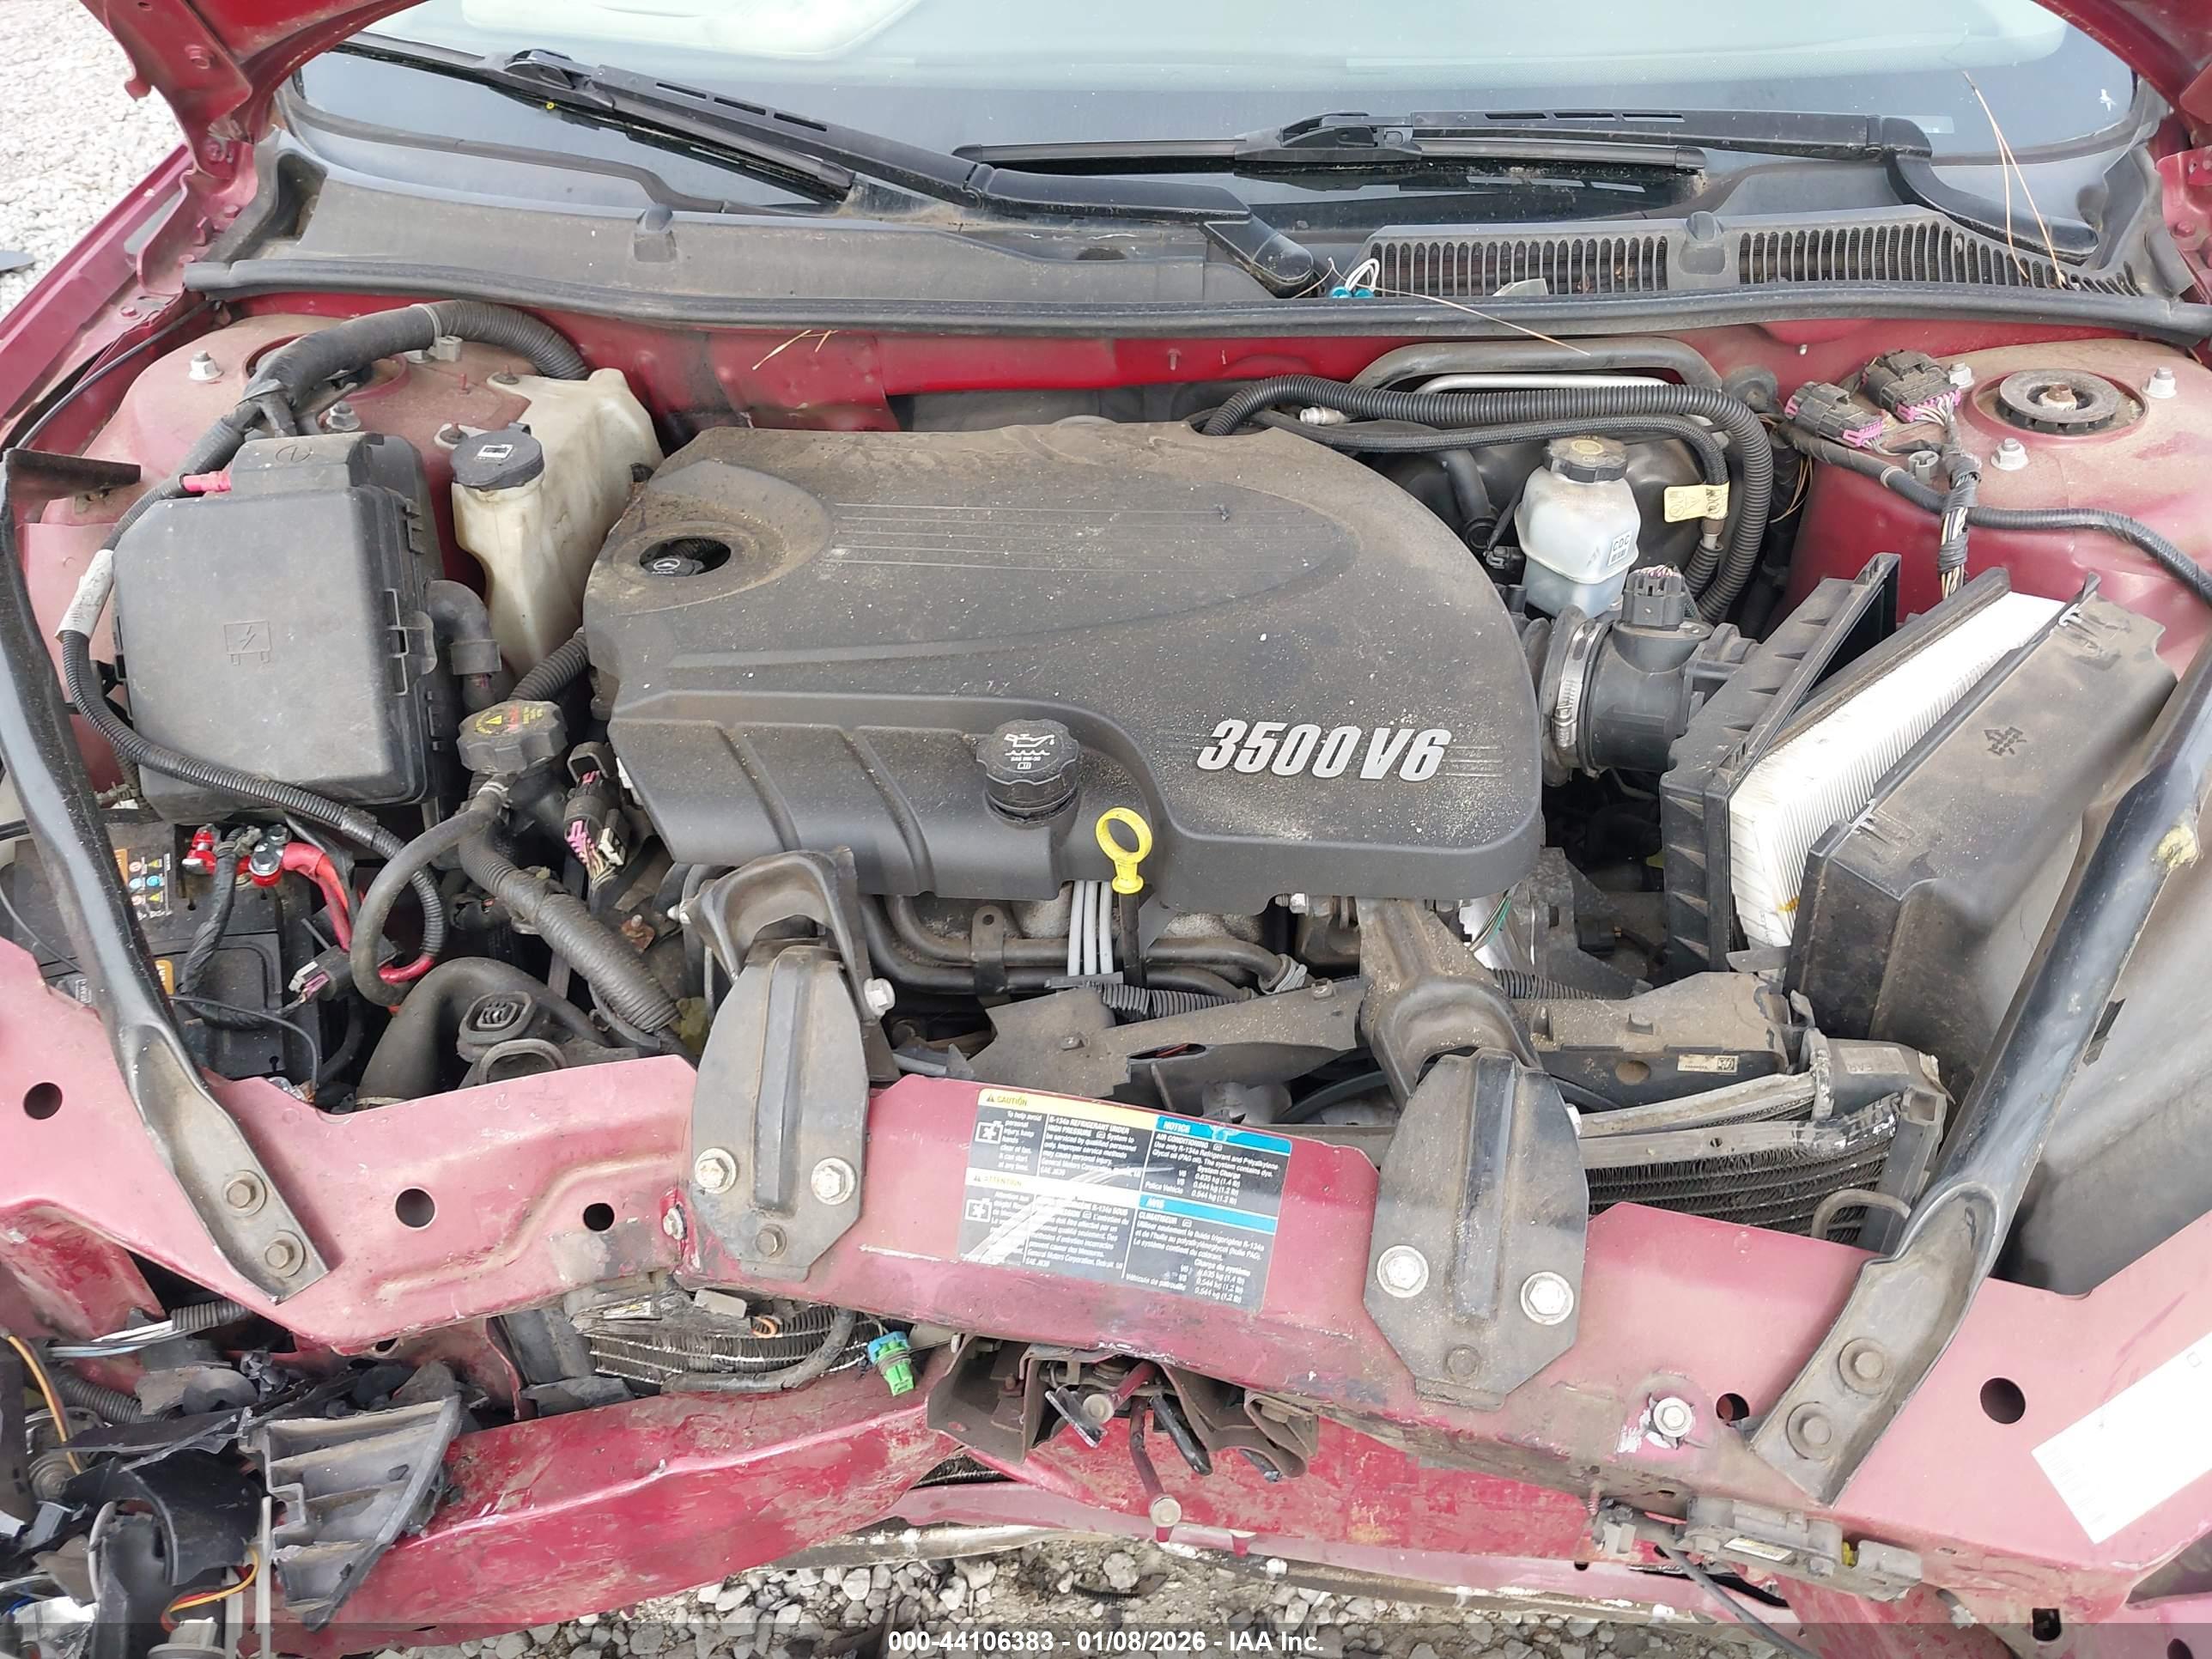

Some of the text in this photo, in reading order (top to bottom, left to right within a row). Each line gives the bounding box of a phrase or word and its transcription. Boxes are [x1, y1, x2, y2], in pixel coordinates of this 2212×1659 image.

[1613, 534, 1631, 551] CDC
[1196, 719, 1452, 782] 3500 V6
[996, 1096, 1026, 1107] CAUTION
[1061, 1126, 1092, 1137] PRESSURE
[1070, 1119, 1109, 1130] REFRIGERANT
[1109, 1125, 1129, 1134] UNDER
[1163, 1121, 1190, 1133] NOTICE
[1166, 1135, 1209, 1147] CONDITIONING
[1177, 1146, 1200, 1155] R-134a
[1196, 1165, 1241, 1179] System Charge
